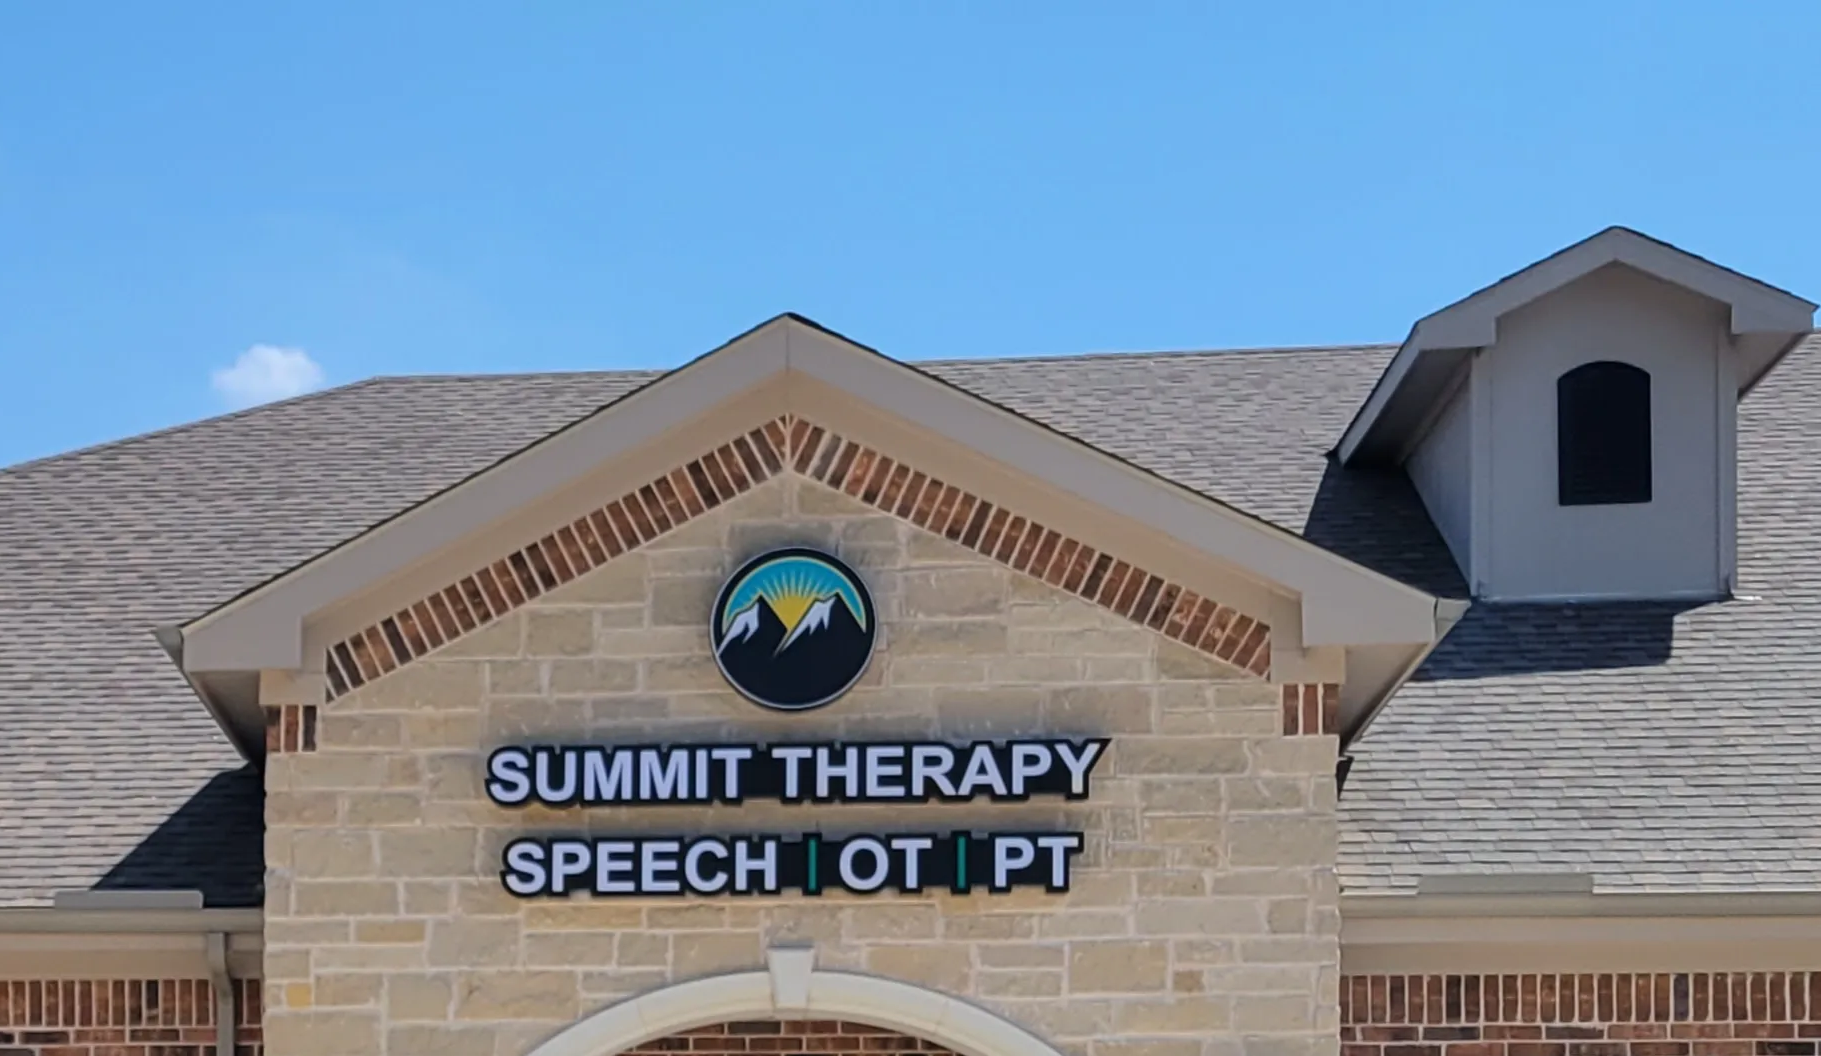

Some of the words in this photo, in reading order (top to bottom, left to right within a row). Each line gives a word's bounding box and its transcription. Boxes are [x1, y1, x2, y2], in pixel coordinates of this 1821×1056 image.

[488, 748, 753, 803] SUMMIT
[771, 743, 1101, 798] THERAPY
[504, 839, 777, 895] SPEECH
[838, 837, 933, 891] OT
[993, 836, 1080, 888] PT
